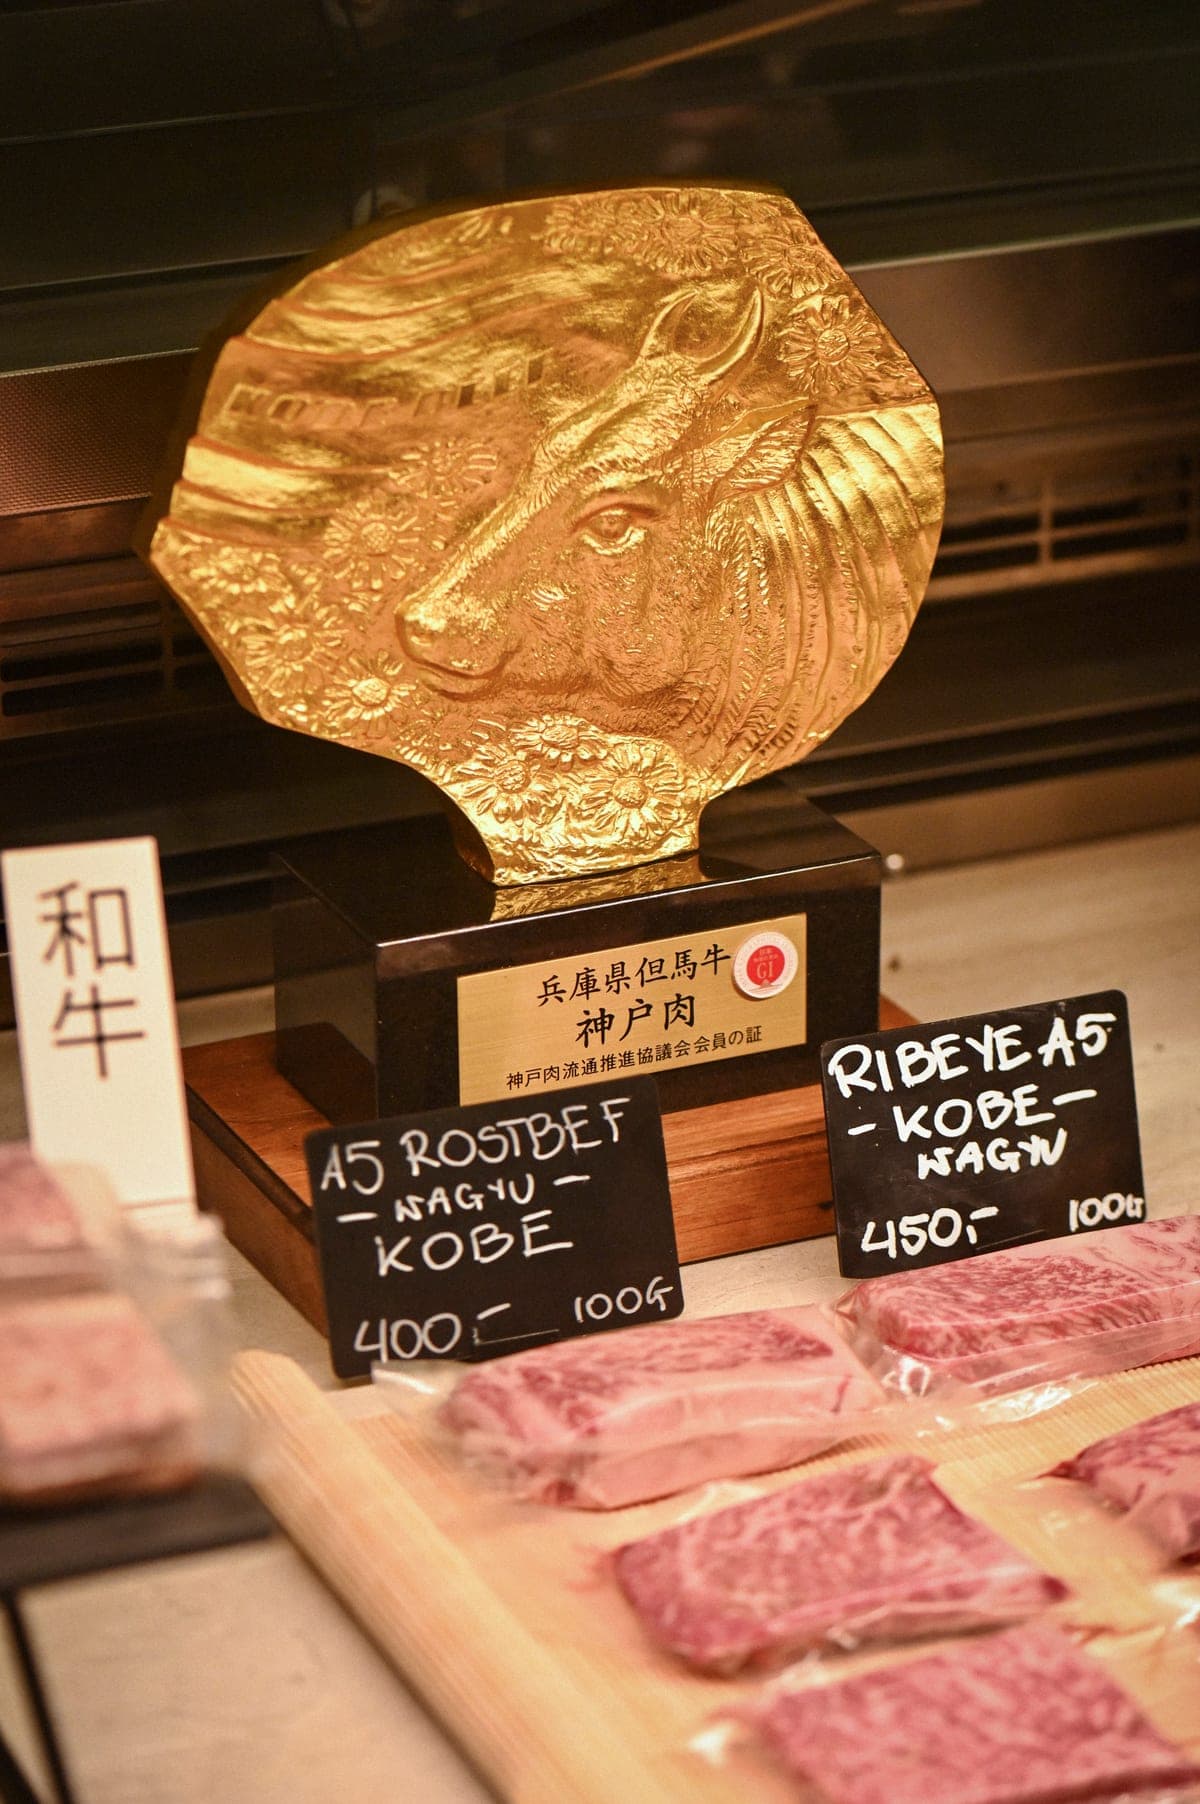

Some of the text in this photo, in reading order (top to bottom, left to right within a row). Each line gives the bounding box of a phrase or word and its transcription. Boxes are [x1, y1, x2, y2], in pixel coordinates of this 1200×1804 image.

[38, 879, 146, 1080] 和牛
[537, 944, 731, 1007] 兵庫県但馬牛
[506, 1025, 763, 1090] 神戸肉流通推進協議会会員の証
[828, 1013, 1117, 1098] RIBEYE A5
[320, 1098, 631, 1195] A5 ROSTBEF
[373, 1209, 574, 1277] KOBE
[574, 1276, 674, 1323] 100G
